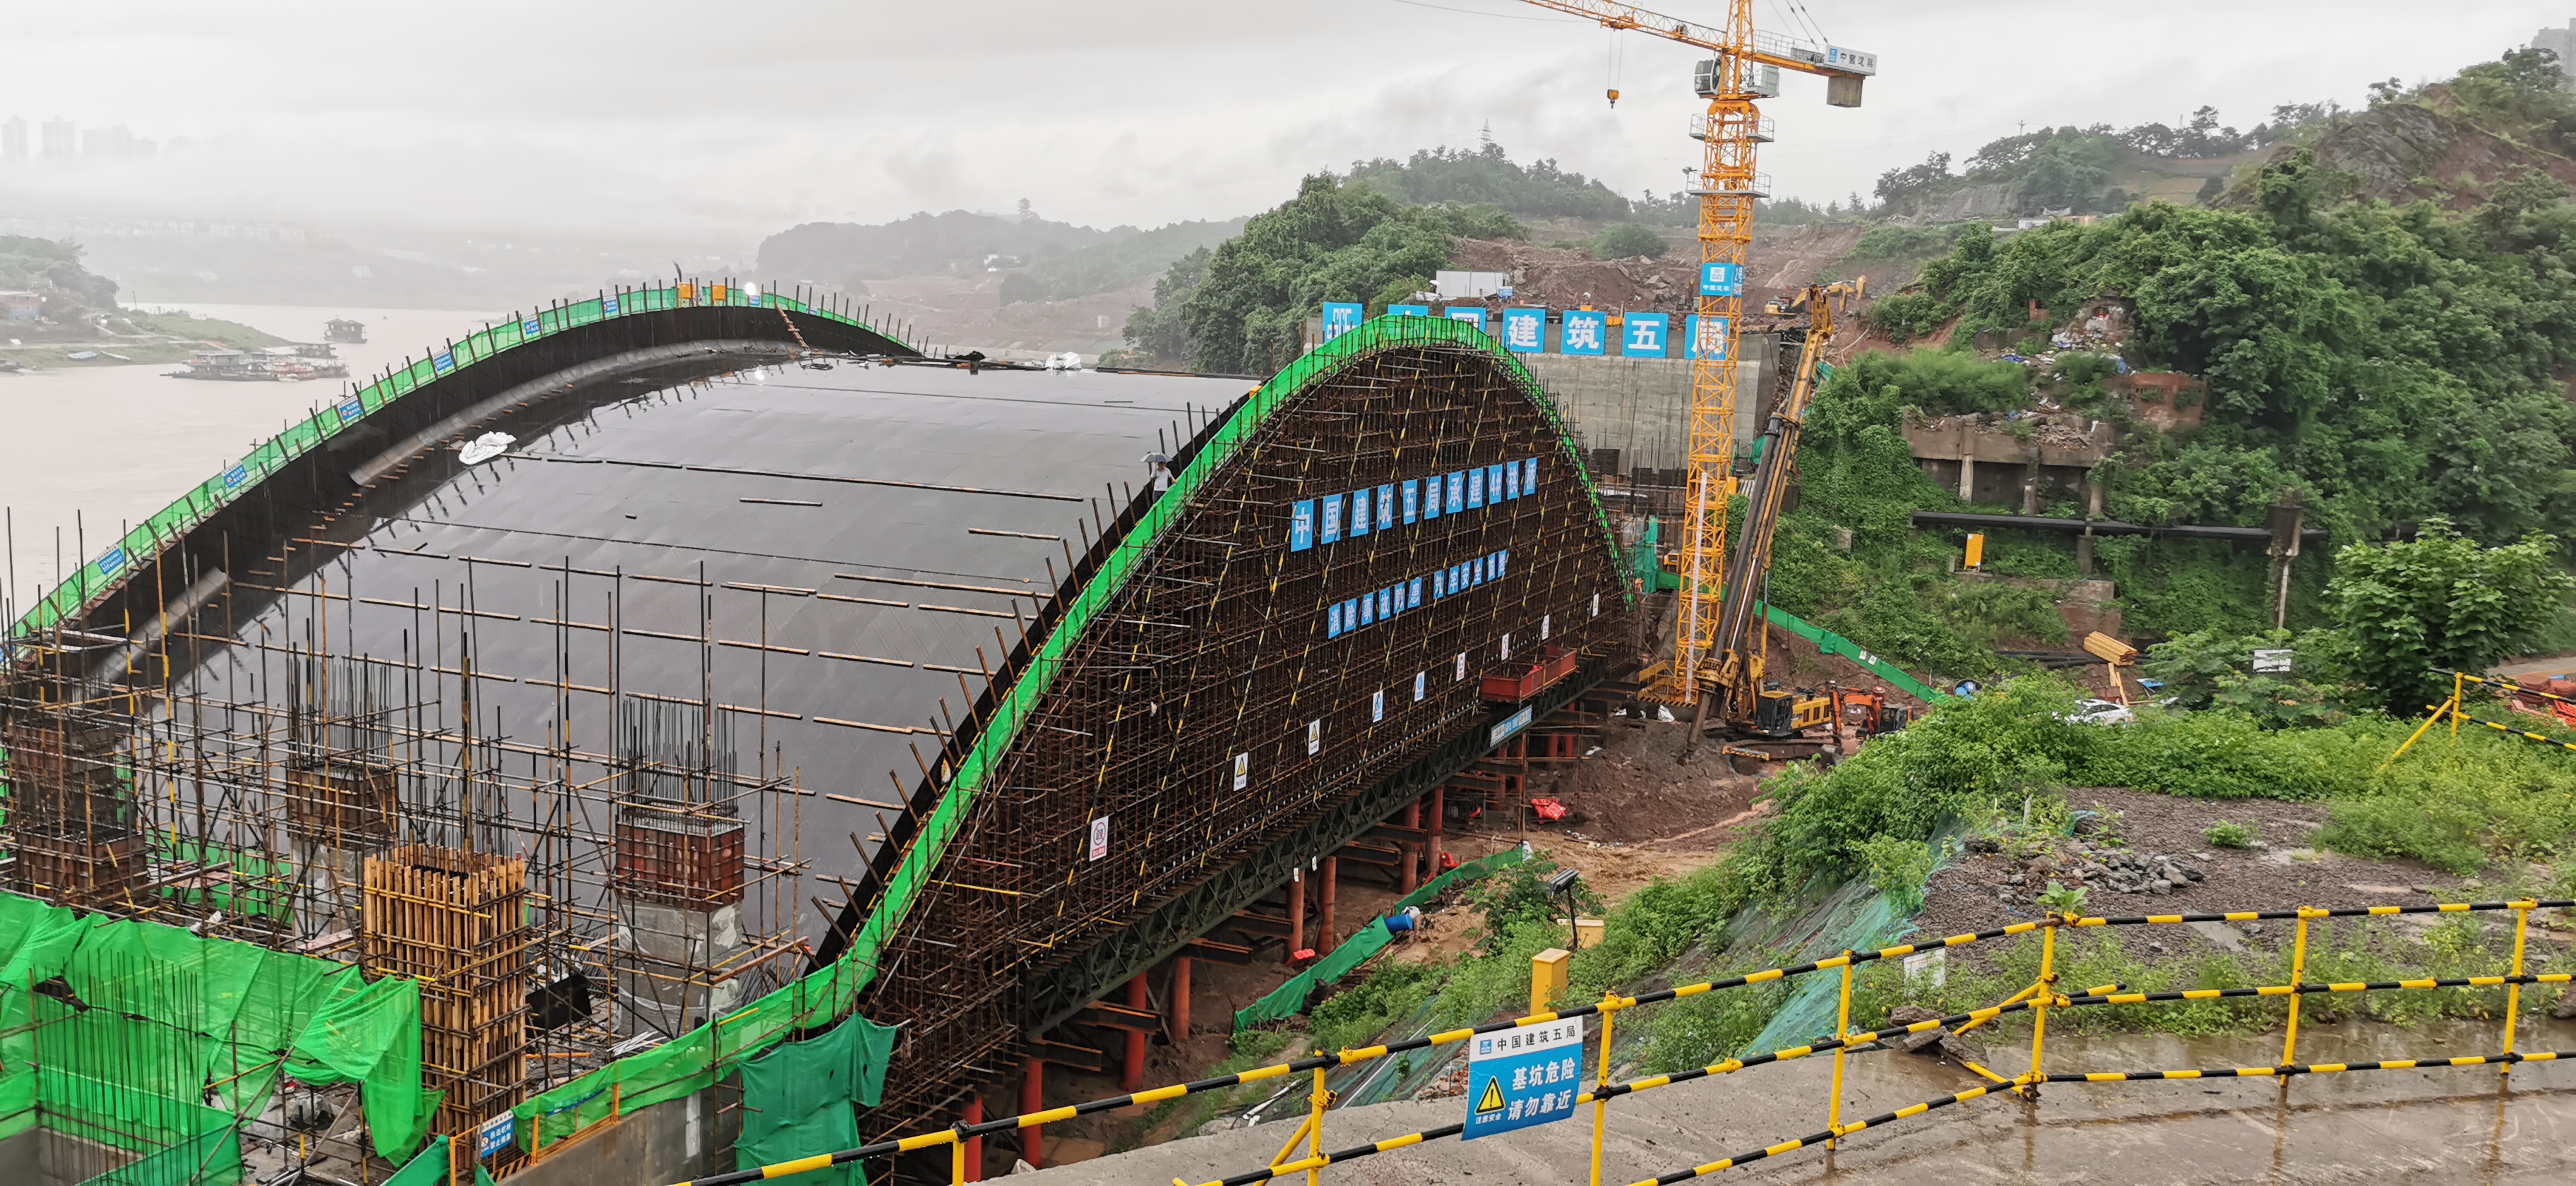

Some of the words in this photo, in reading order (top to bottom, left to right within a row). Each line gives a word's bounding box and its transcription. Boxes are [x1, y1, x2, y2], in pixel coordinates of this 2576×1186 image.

[1497, 1025, 1575, 1050] 中国建筑五局
[1512, 1057, 1576, 1091] 基坑危险
[1508, 1089, 1572, 1120] 请勿靠近
